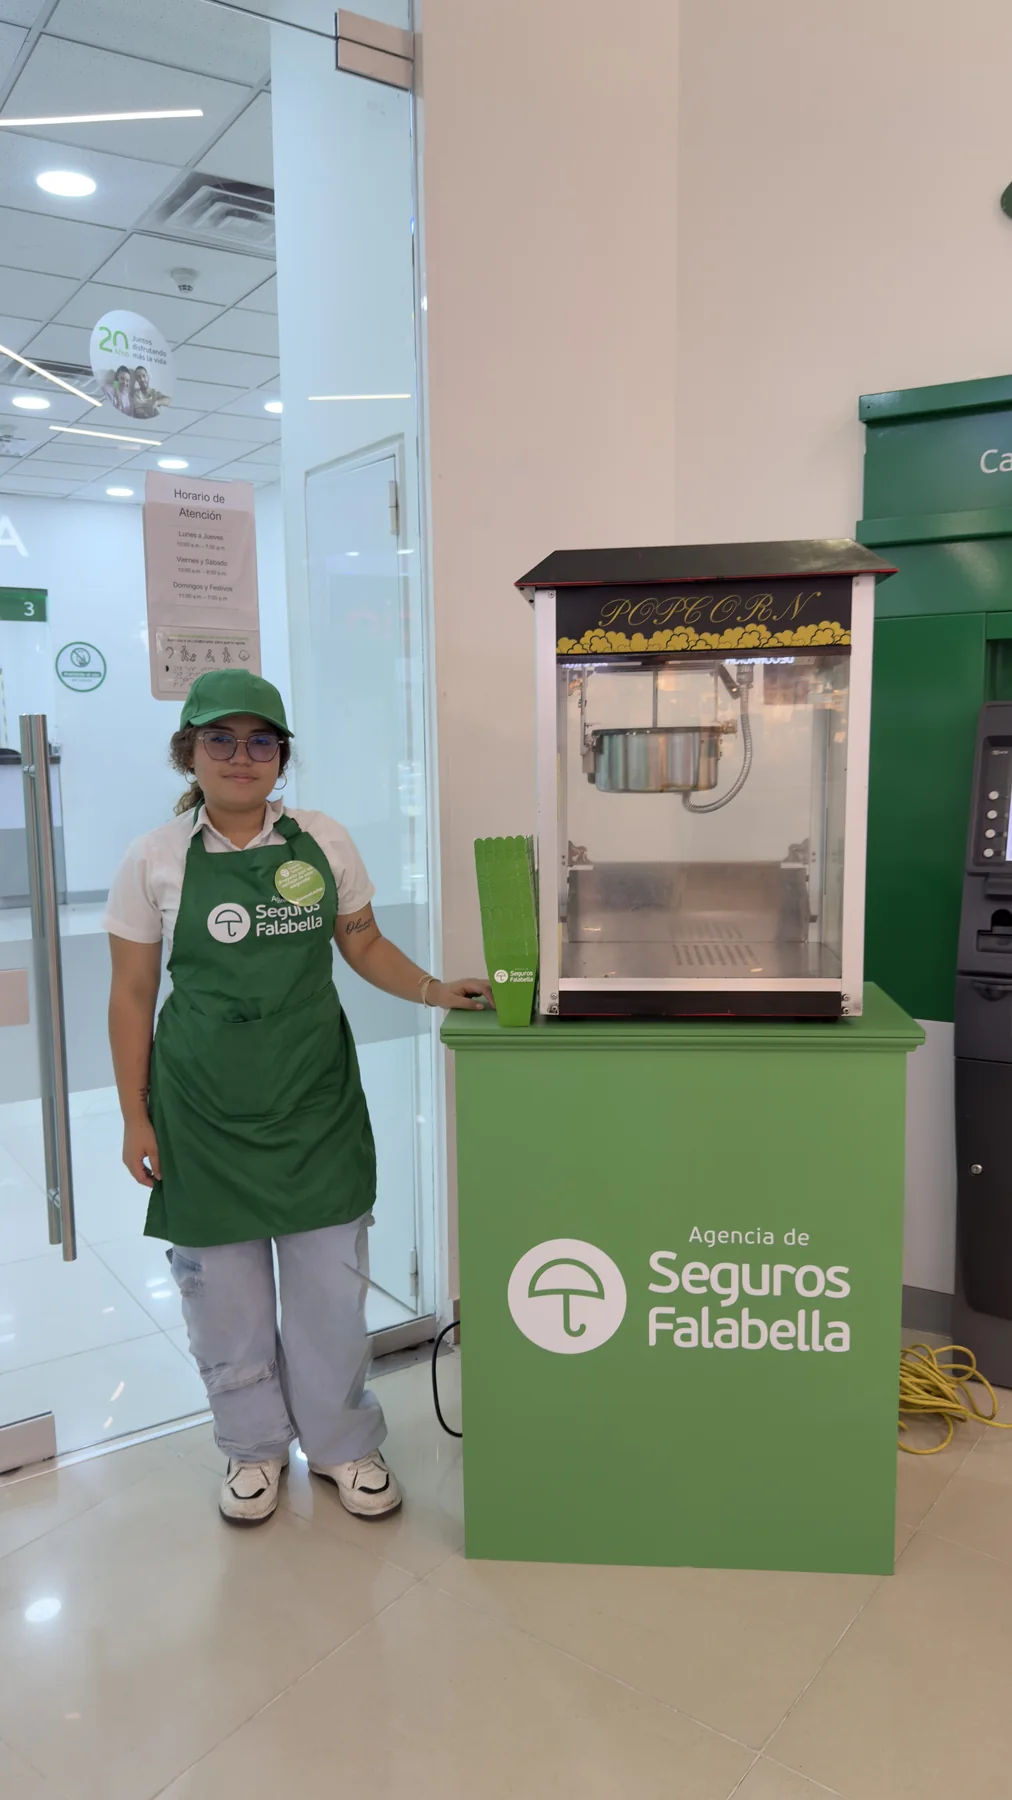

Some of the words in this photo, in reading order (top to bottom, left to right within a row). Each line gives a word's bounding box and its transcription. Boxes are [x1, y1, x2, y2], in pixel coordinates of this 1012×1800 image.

[131, 335, 153, 346] Juntos
[131, 344, 167, 357] disfrutando
[174, 489, 211, 503] Horario
[213, 493, 226, 504] de
[178, 508, 222, 521] Atención
[178, 531, 197, 539] Lunes
[203, 533, 224, 541] Jueves
[176, 556, 200, 565] Viernes
[173, 581, 204, 591] Domingos
[209, 584, 233, 592] Festivos
[23, 601, 35, 617] 3
[598, 591, 822, 627] POPCORN
[255, 915, 323, 937] Falabella
[510, 970, 534, 978] Seguros
[688, 1226, 775, 1248] Agencia
[783, 1227, 810, 1246] de
[648, 1250, 851, 1308] Seguros
[648, 1306, 851, 1353] Falabella
